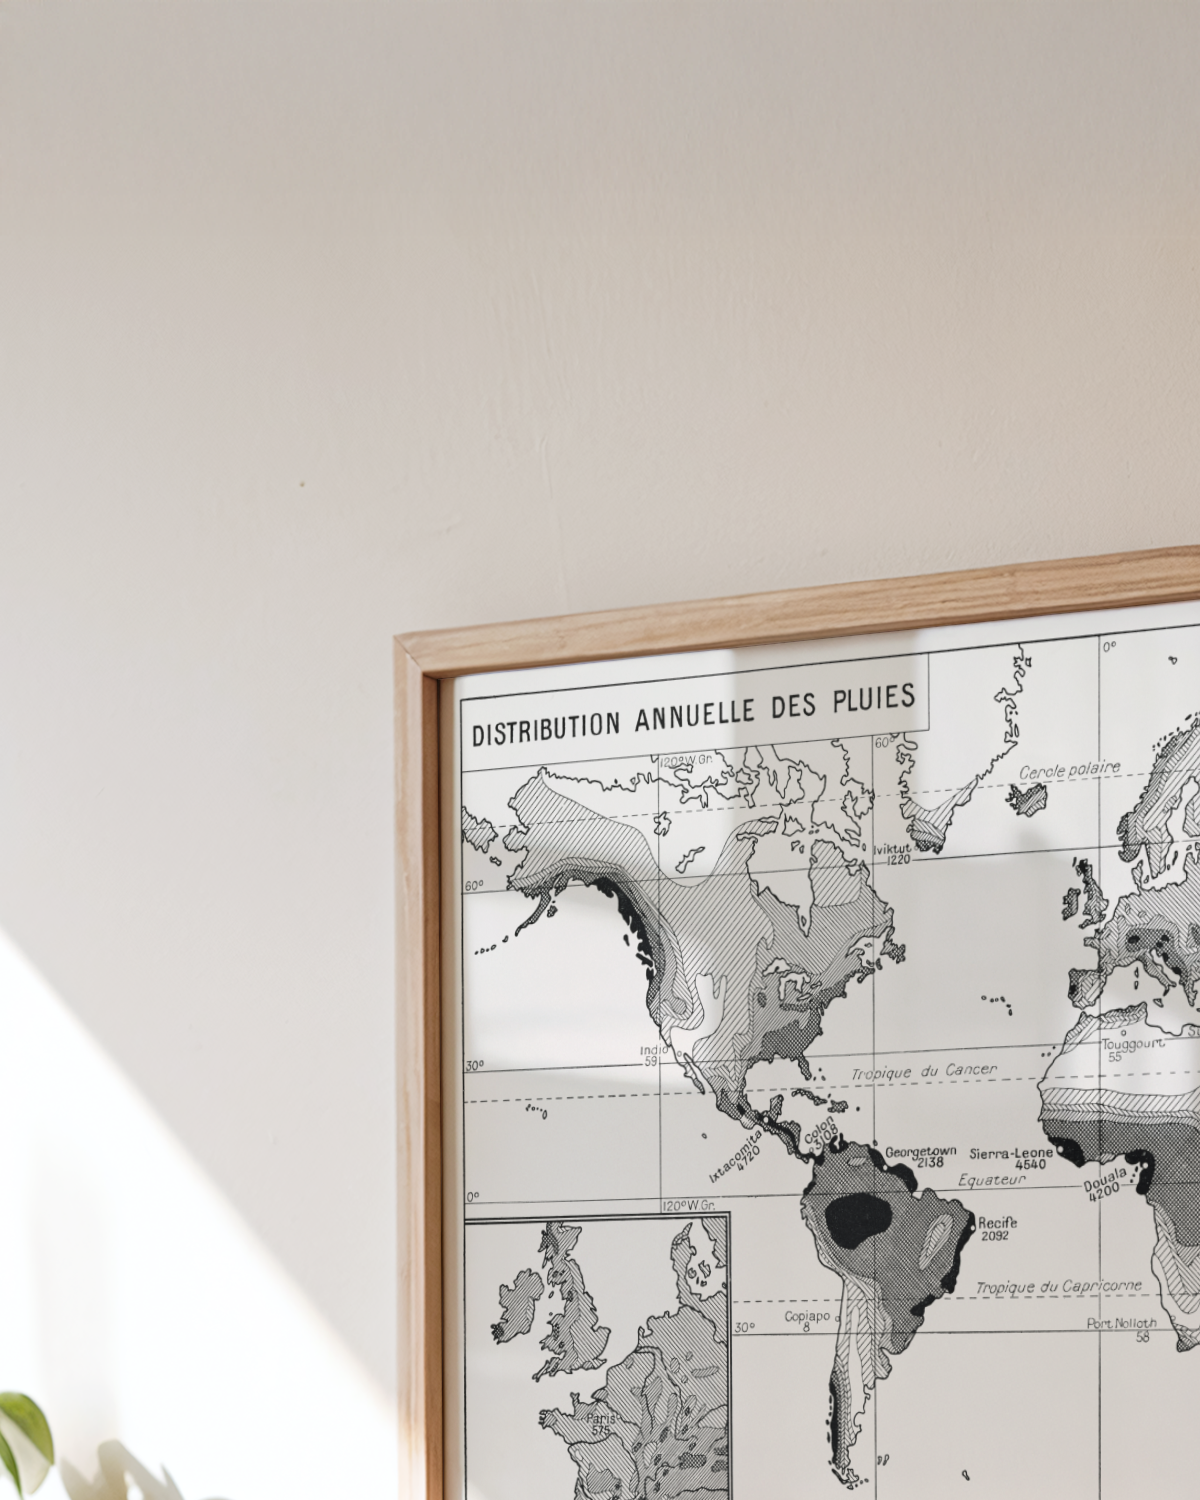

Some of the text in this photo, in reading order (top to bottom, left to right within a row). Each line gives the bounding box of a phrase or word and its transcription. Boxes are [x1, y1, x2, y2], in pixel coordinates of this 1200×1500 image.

[471, 682, 916, 748] DISTRIBUTION ANNUELLE DES PLUIES
[1019, 759, 1121, 781] Cercle polaire
[886, 854, 911, 866] 1220
[1101, 1037, 1166, 1054] Touggourt
[644, 1056, 658, 1067] 59
[1108, 1050, 1123, 1062] 55
[851, 1063, 998, 1083] Tropique du Cancer
[813, 1124, 839, 1151] 3108
[708, 1129, 763, 1184] Ixtacomita
[736, 1145, 761, 1172] 4720
[885, 1147, 957, 1158] Georgetown
[969, 1146, 1054, 1160] Sierra-Leone
[917, 1157, 944, 1168] 2138
[1015, 1157, 1047, 1170] 4540
[958, 1172, 1026, 1188] Equateur
[1083, 1167, 1128, 1194] Douala
[1089, 1181, 1120, 1202] 4200
[978, 1216, 1018, 1231] Recife
[981, 1230, 1009, 1242] 2092
[976, 1277, 1142, 1296] Tropique du Capricorne
[785, 1310, 830, 1325] Copiapo
[1086, 1318, 1112, 1330] Port
[803, 1322, 810, 1333] 8
[1136, 1330, 1150, 1343] 58
[586, 1412, 615, 1425] Paris
[591, 1425, 610, 1436] 575
